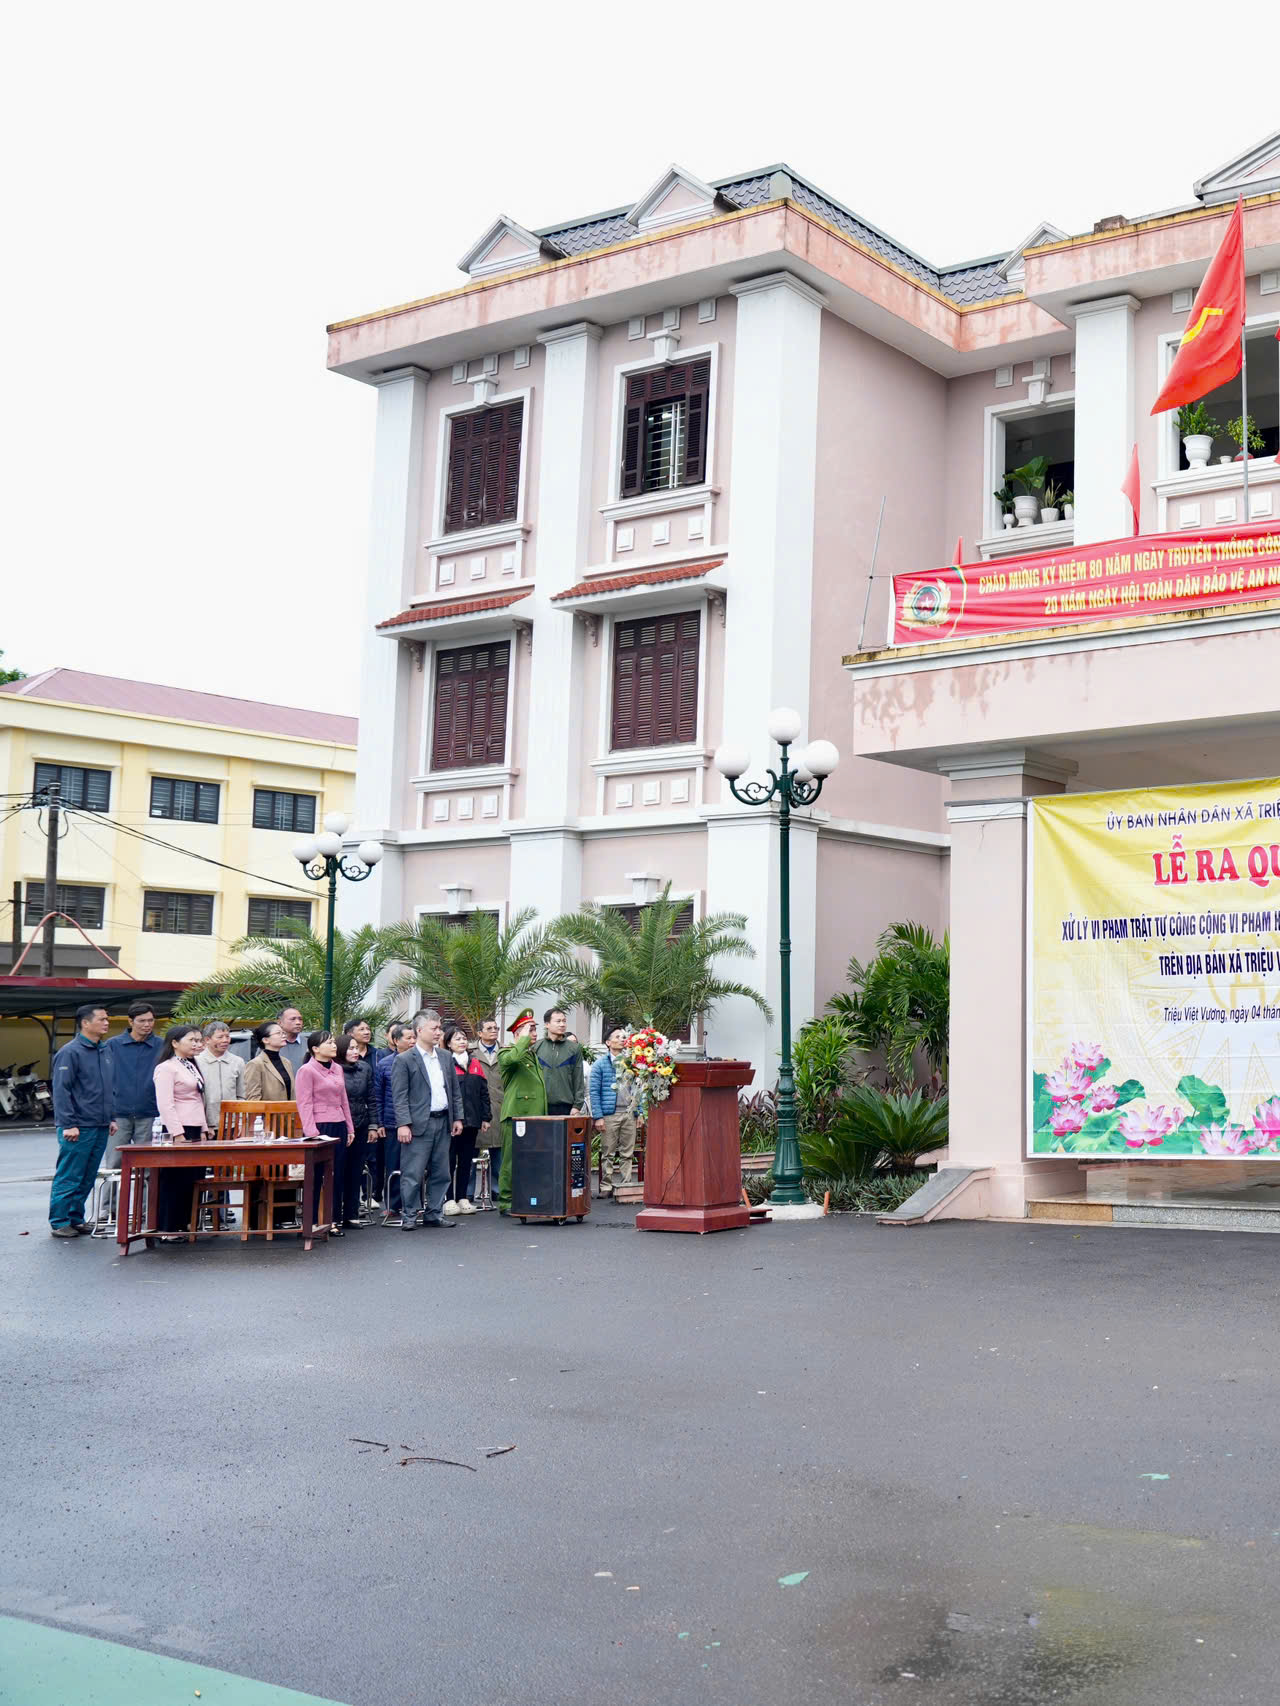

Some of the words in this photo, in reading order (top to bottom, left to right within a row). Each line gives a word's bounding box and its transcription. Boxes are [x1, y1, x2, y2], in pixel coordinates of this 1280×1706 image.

[979, 572, 1006, 594] CHÀO
[1009, 567, 1040, 590] MỪNG
[1059, 559, 1086, 586] NIỆM
[1089, 559, 1102, 579] 80
[1106, 552, 1131, 576] NĂM
[1134, 547, 1164, 571] NGÀY
[1168, 538, 1212, 568] TRUYỀN
[1215, 533, 1254, 560] THỐNG
[1044, 595, 1058, 615] 20
[1061, 590, 1086, 612] NĂM
[1088, 584, 1118, 609] NGÀY
[1121, 581, 1140, 607] HỘI
[1143, 577, 1172, 601] TOÀN
[1176, 574, 1200, 597] DÂN
[1203, 566, 1226, 594] BẢO
[1230, 567, 1245, 594] VỆ
[1247, 568, 1265, 588] AN
[1107, 811, 1123, 830] ỦY
[1127, 813, 1154, 829] BAN
[1158, 808, 1197, 827] NHÂN
[1201, 805, 1230, 823] DÂN
[1235, 802, 1254, 820] XÃ
[1152, 834, 1188, 885] LỄ
[1195, 848, 1240, 882] RA
[1062, 912, 1075, 941] XỬ
[1077, 917, 1089, 940] LÝ
[1091, 920, 1100, 940] VI
[1102, 918, 1128, 943] PHẠM
[1130, 913, 1152, 942] TRẬT
[1154, 914, 1168, 941] TỰ
[1169, 912, 1196, 936] CÔNG
[1199, 910, 1226, 939] CỘNG
[1229, 912, 1239, 933] VI
[1242, 911, 1271, 937] PHẠM
[1159, 951, 1183, 976] TRÊN
[1186, 954, 1201, 979] ĐỊA
[1205, 949, 1226, 974] BÀN
[1229, 948, 1242, 974] XÃ
[1245, 947, 1274, 977] TRIỆU
[1164, 1007, 1182, 1024] Triệu
[1184, 1007, 1199, 1024] Việt
[1200, 1007, 1227, 1024] Vương,
[1230, 1005, 1250, 1024] ngày
[1251, 1005, 1261, 1019] 04
